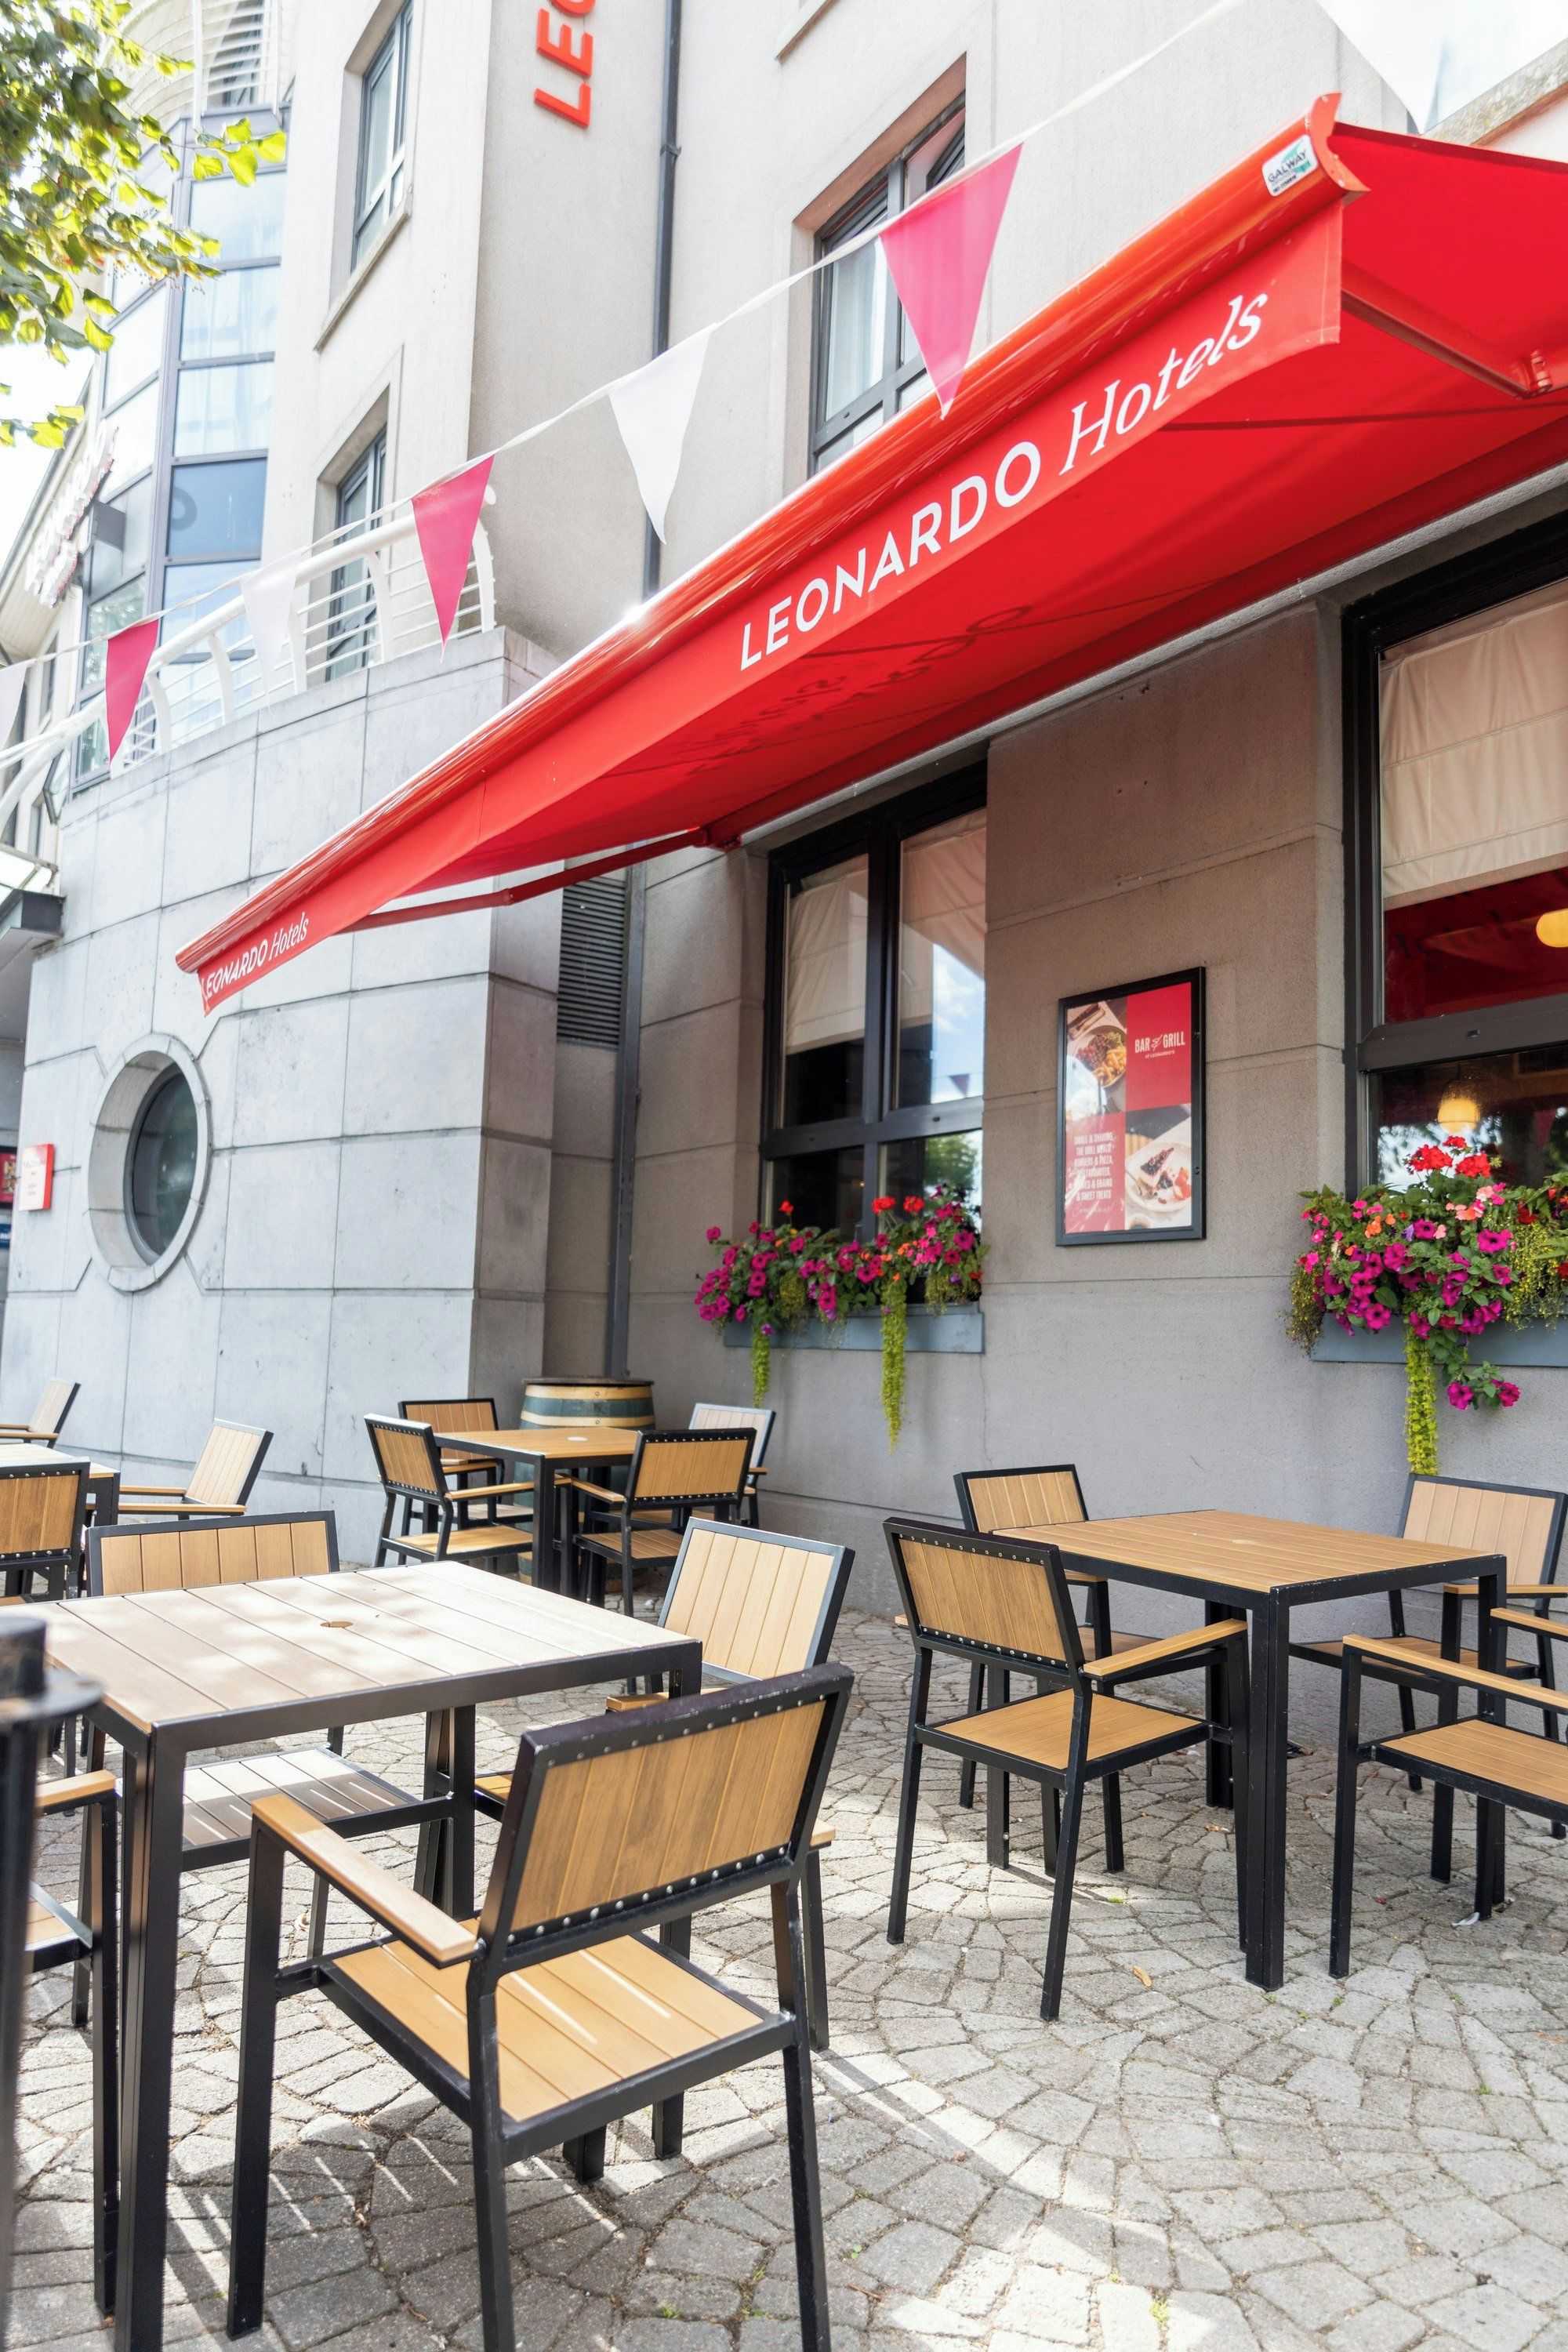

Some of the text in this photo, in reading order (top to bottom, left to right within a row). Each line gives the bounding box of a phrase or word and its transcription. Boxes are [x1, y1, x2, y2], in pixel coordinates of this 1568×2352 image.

[1269, 149, 1306, 183] GALWAY
[740, 294, 1268, 671] LEONARDO Hotels
[268, 911, 309, 961] Hotels
[1134, 1037, 1150, 1054] BAR
[1163, 1031, 1185, 1048] GRILL
